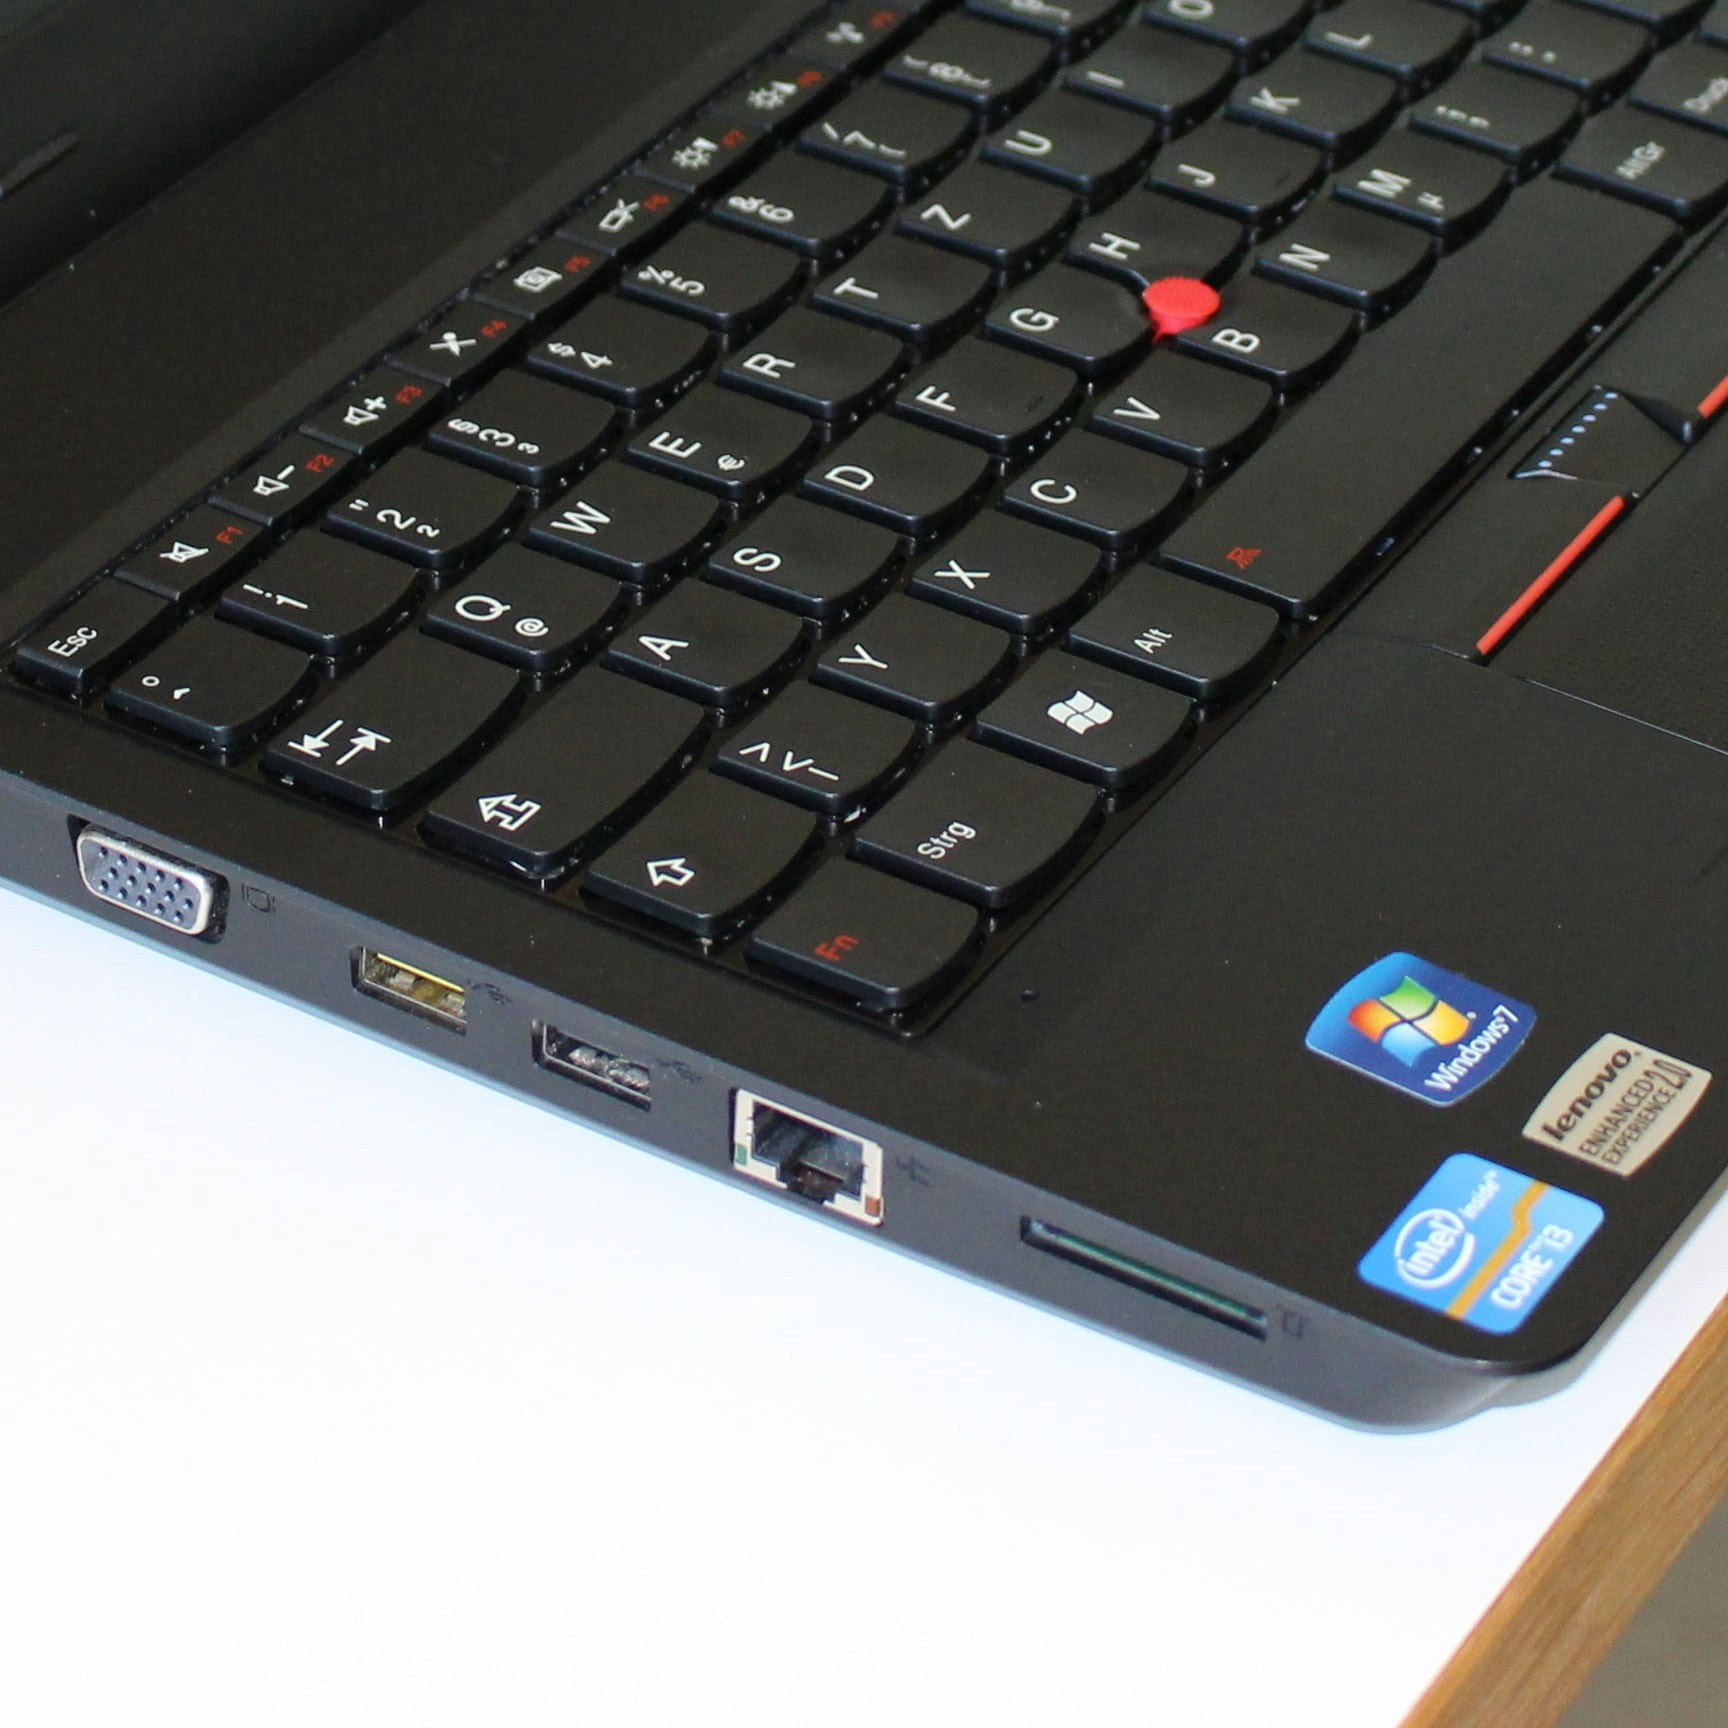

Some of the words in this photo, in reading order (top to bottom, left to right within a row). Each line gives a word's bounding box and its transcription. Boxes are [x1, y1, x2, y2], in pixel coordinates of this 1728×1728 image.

[1327, 33, 1372, 49] L
[1250, 89, 1299, 114] K
[1004, 131, 1051, 155] U
[1179, 166, 1215, 186] J
[1357, 171, 1410, 198] M
[922, 206, 970, 229] Z
[1090, 234, 1140, 260] H
[1275, 245, 1330, 271] N
[835, 279, 878, 299] T
[480, 320, 508, 337] F4
[1010, 310, 1058, 332] G
[1212, 331, 1259, 353] B
[744, 355, 795, 378] R
[395, 385, 423, 405] F3
[917, 388, 955, 411] F
[1114, 399, 1160, 419] V
[650, 433, 701, 457] E
[305, 453, 335, 473] F2
[719, 457, 746, 470] €
[826, 467, 873, 490] D
[1032, 481, 1076, 503] C
[552, 503, 610, 533] W
[216, 526, 244, 544] F1
[735, 550, 780, 571] S
[936, 562, 989, 588] X
[457, 597, 510, 620] Q
[517, 620, 548, 639] @
[49, 629, 96, 656] Esc
[640, 638, 688, 660] A
[1136, 631, 1171, 653] Alt
[840, 646, 887, 668] Y
[919, 824, 975, 858] Strg
[817, 937, 857, 960] Fn
[1541, 1049, 1635, 1143] lenovo
[1579, 1078, 1654, 1158] ENHANCED
[1601, 1088, 1676, 1167] EXPERIENCE
